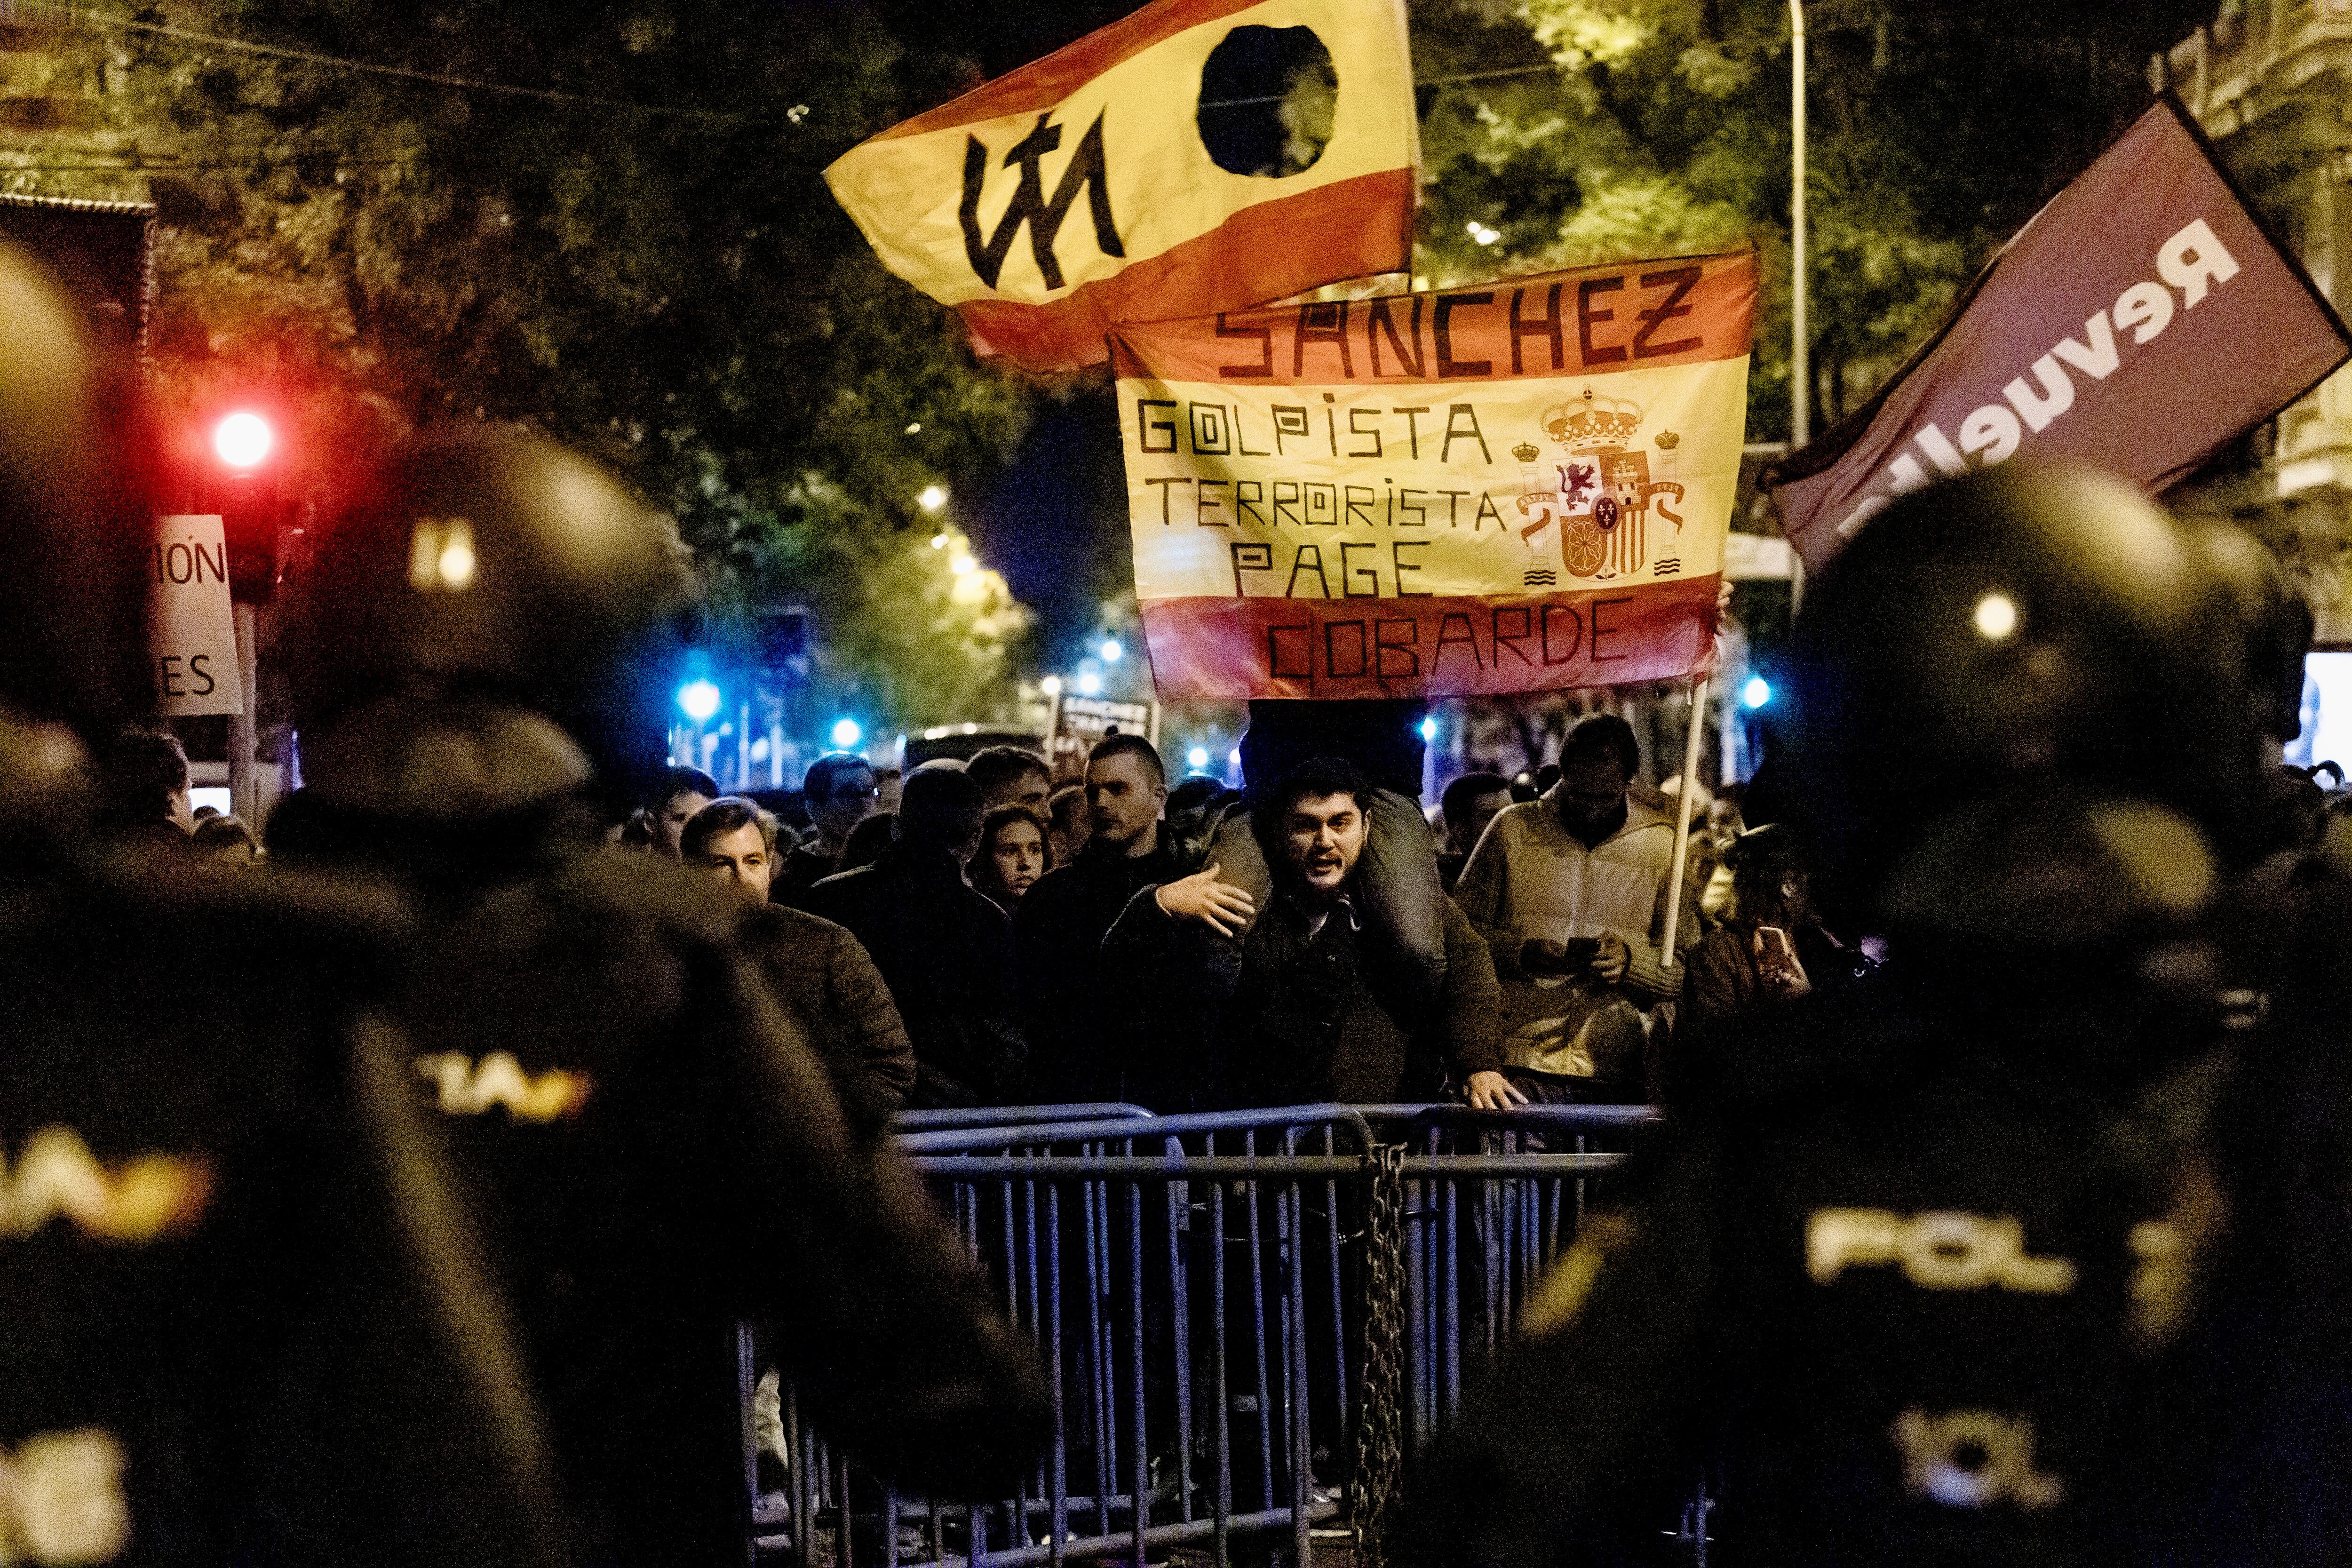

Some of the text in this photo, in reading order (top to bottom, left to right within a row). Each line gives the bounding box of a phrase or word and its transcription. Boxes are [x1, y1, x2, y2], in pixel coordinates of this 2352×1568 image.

[1215, 266, 1703, 378] SANCHEZ
[1230, 541, 1434, 598] PAGE
[1267, 597, 1633, 679] COBARDE
